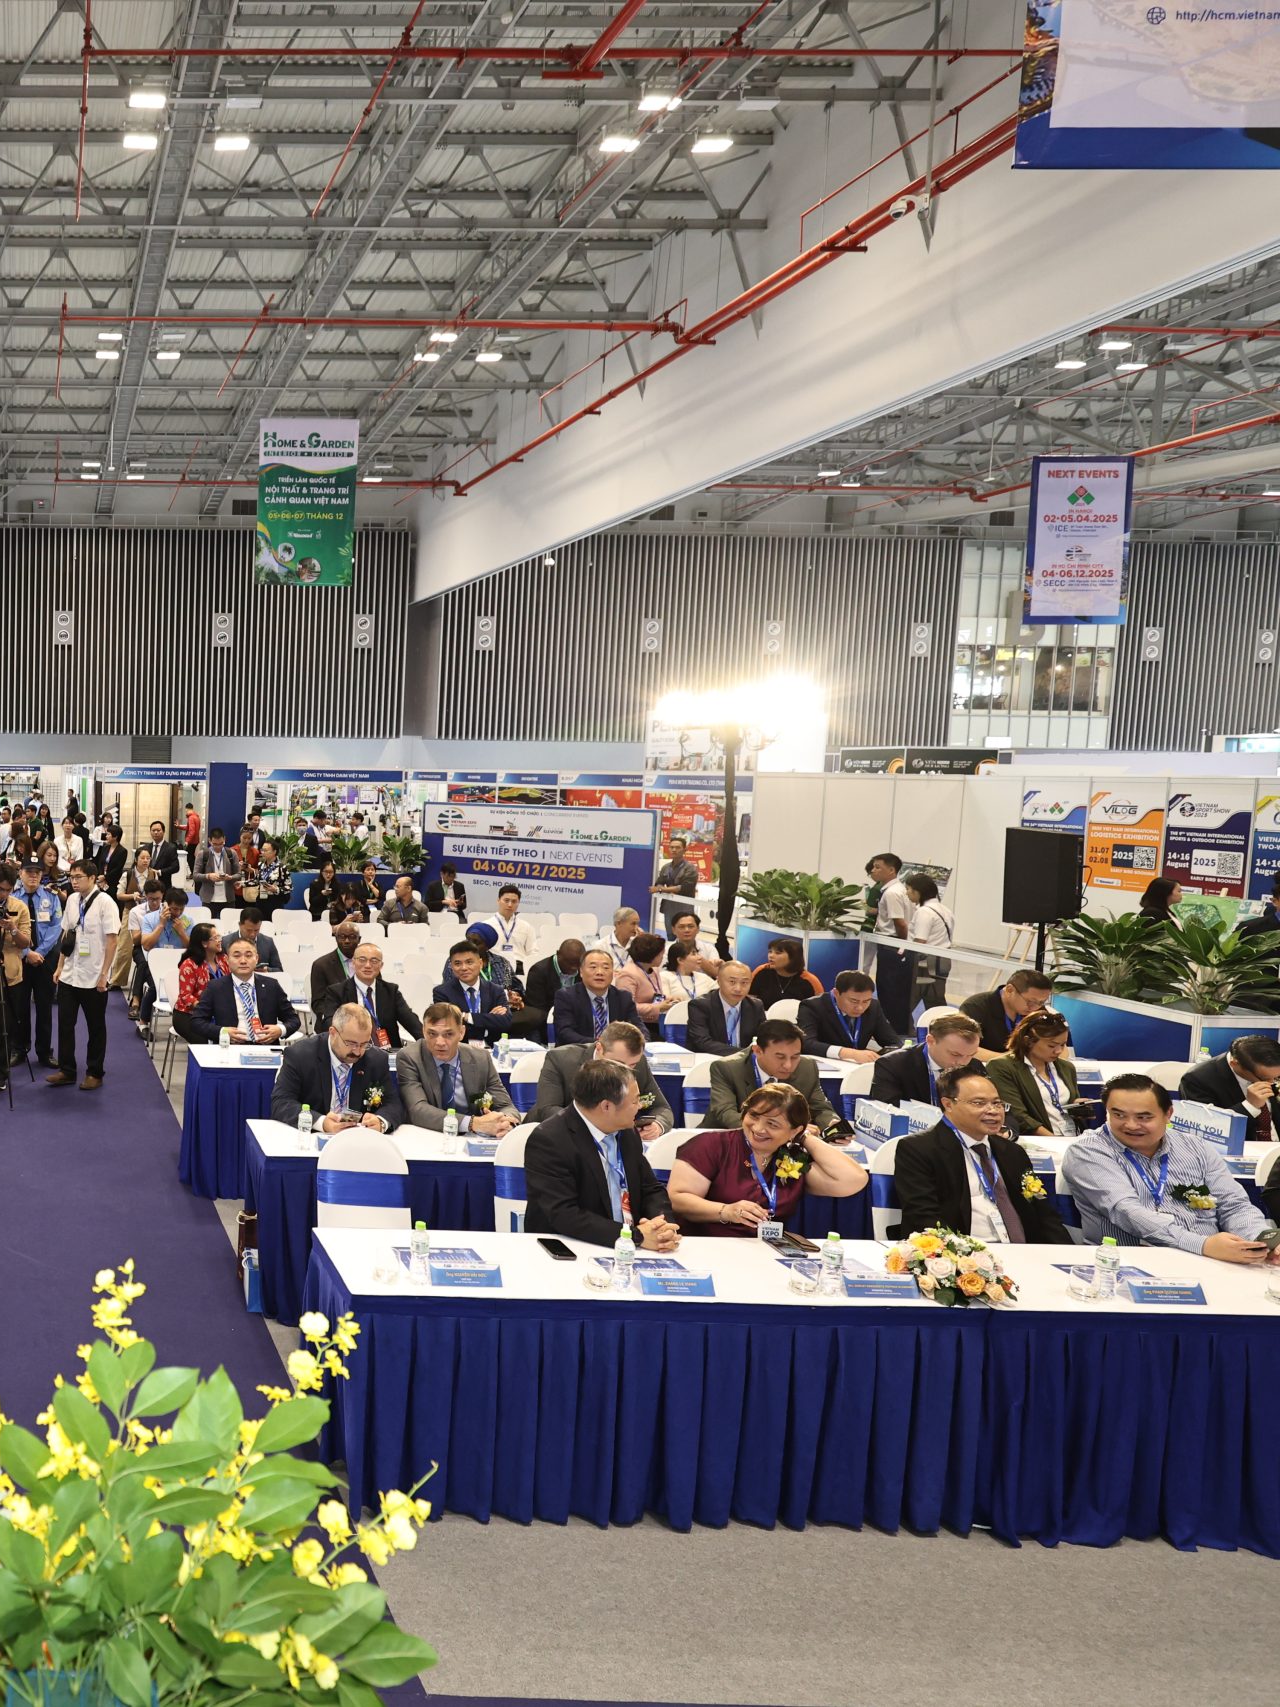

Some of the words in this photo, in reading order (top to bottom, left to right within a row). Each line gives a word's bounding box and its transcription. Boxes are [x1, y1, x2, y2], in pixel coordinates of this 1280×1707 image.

[263, 432, 297, 448] HOME
[299, 440, 306, 448] &
[307, 432, 355, 449] GARDEN
[1048, 470, 1076, 478] NEXT
[1078, 470, 1119, 478] EVENTS
[265, 484, 280, 495] NỘI
[281, 484, 300, 494] THẤT
[338, 486, 349, 494] TRÍ
[264, 494, 287, 504] CẢNH
[313, 496, 329, 506] VIỆT
[1043, 514, 1056, 523] 02
[1061, 514, 1118, 523] 05.04.2025
[1060, 570, 1114, 578] 06.12.2025
[1102, 805, 1138, 815] VILOG
[570, 829, 593, 840] HOME
[599, 830, 631, 842] GARDEN
[1123, 833, 1159, 841] EXHIBITION
[452, 843, 464, 853] SỰ
[466, 843, 488, 857] KIỆN
[491, 844, 510, 856] TIẾP
[513, 848, 538, 858] THEO
[549, 851, 574, 861] NEXT
[576, 853, 613, 863] EVENTS
[1113, 851, 1133, 860] 2025
[1089, 856, 1108, 864] 02.08
[1194, 858, 1216, 866] 2025
[473, 860, 489, 872] 04
[498, 861, 586, 880] 06/12/2025
[473, 879, 492, 888] SECC,
[537, 884, 553, 893] CITY,
[555, 886, 584, 895] VIETNAM
[1174, 1116, 1201, 1129] THANK
[1204, 1126, 1223, 1136] YOU
